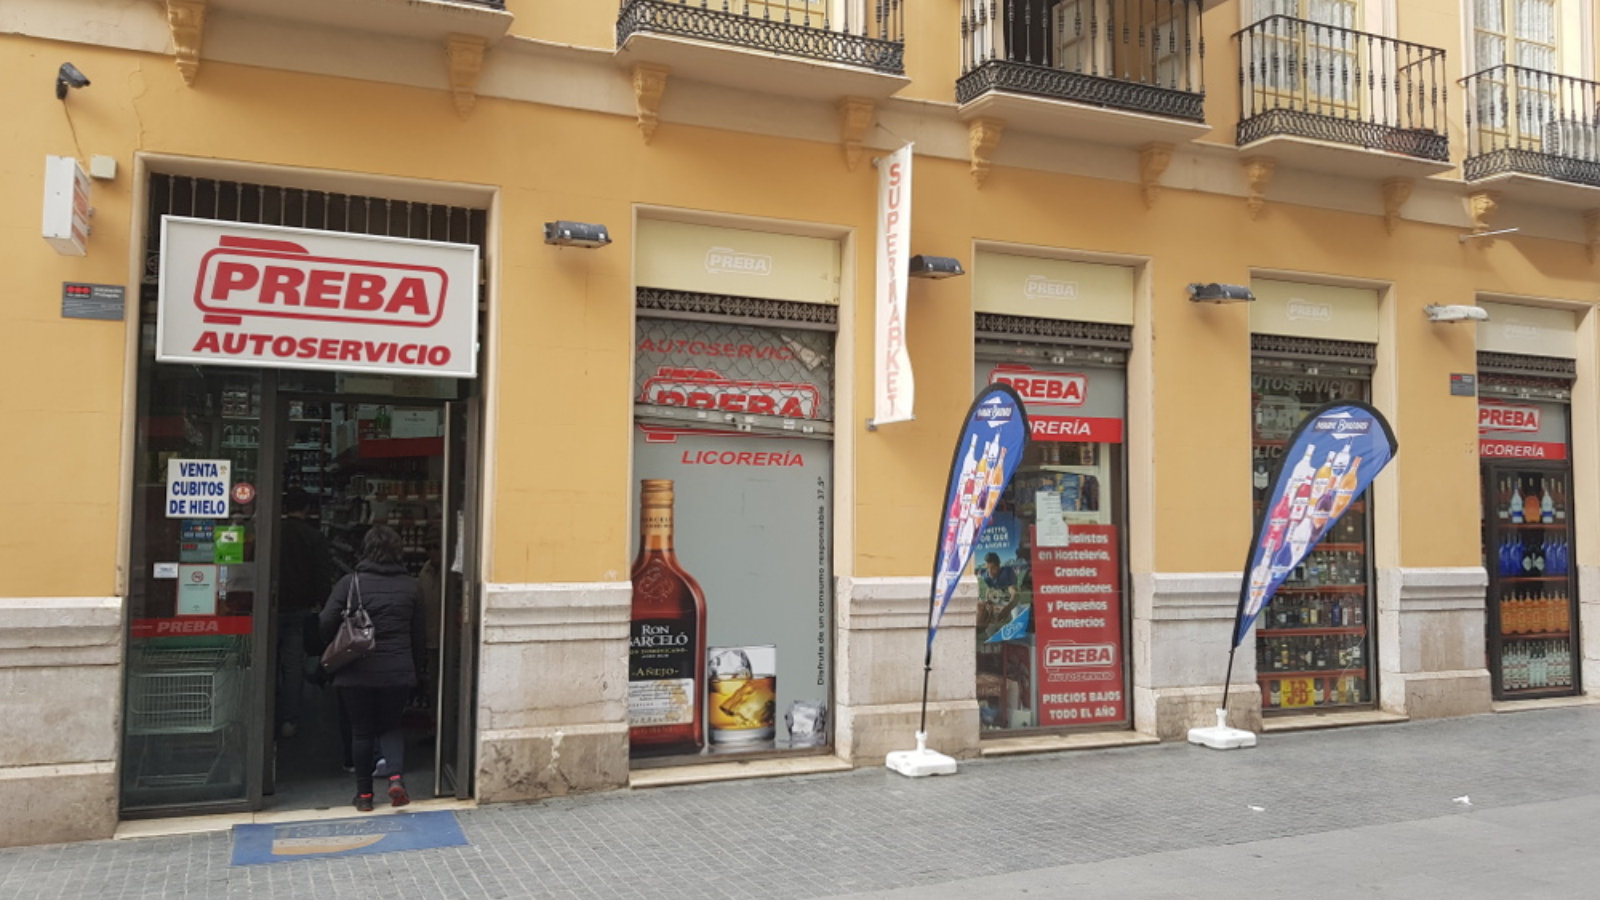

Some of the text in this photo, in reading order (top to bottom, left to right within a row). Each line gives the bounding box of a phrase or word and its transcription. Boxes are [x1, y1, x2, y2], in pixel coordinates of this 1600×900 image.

[710, 254, 767, 271] PREBA
[211, 261, 431, 315] PREBA
[885, 163, 902, 417] SUPERMARKET
[1028, 281, 1074, 297] PREBA
[192, 331, 451, 366] AUTOSERVICIO
[637, 339, 798, 361] AUTOSERVIC
[1253, 376, 1356, 394] UTOSERVICIO
[1479, 408, 1537, 428] PREBA
[1481, 442, 1545, 457] ICORERÍA
[681, 450, 804, 467] LICORERÍA
[179, 462, 218, 478] VENTA
[172, 481, 225, 496] CUBITOS
[169, 500, 226, 515] DE HIELO
[817, 506, 826, 566] responsable
[1038, 551, 1052, 560] en
[1054, 566, 1097, 577] Grandes
[1040, 583, 1112, 594] consumidores
[1047, 599, 1107, 612] y Pequeños
[157, 620, 219, 633] PREBA
[818, 616, 825, 629] un
[1051, 617, 1105, 628] Comercios
[817, 632, 825, 644] de
[1048, 648, 1111, 663] PREBA
[817, 646, 825, 686] Disfruta
[1043, 691, 1121, 704] PRECIOS BAJOS
[1049, 705, 1116, 720] TODO EL AÑO
